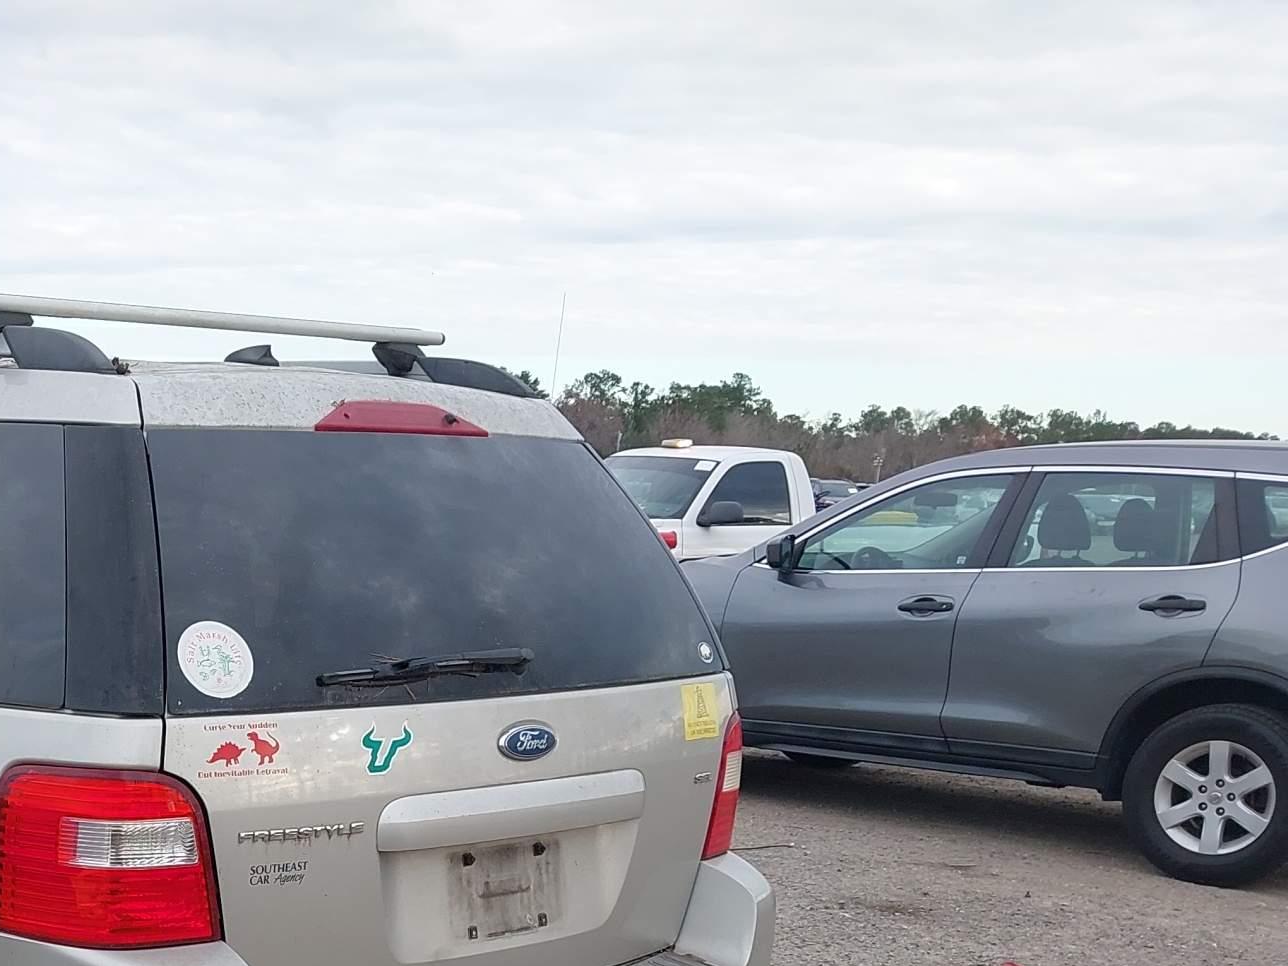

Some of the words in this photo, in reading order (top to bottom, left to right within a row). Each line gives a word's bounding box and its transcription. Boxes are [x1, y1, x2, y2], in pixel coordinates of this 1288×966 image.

[517, 731, 548, 751] Ford
[238, 821, 365, 844] FREESTYLE
[250, 861, 308, 875] SOUTHEAST
[249, 875, 270, 886] CAR
[273, 872, 305, 886] Agency
